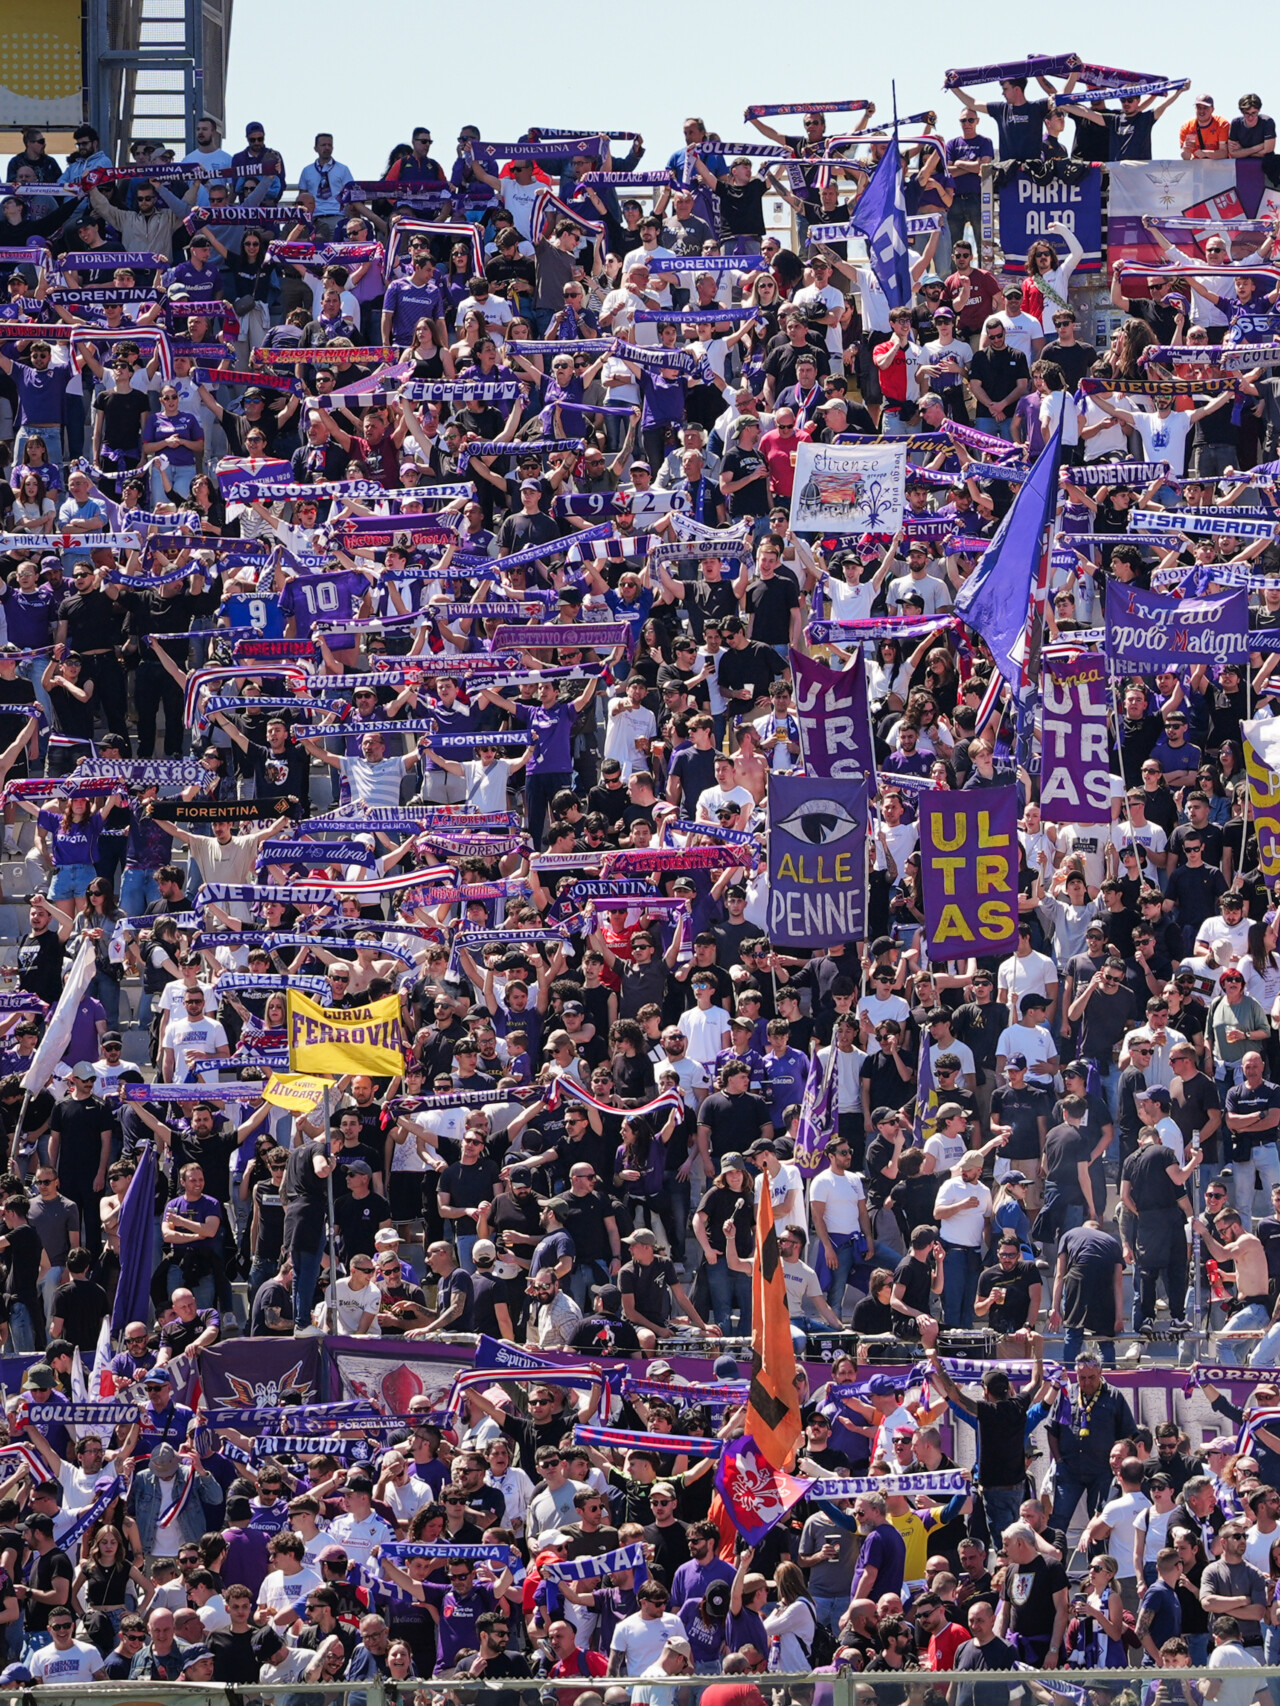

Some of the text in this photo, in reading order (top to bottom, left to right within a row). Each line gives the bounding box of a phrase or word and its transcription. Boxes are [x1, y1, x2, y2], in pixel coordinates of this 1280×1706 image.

[504, 144, 570, 154] FIORENTINA
[106, 166, 183, 178] FIORENTINA
[603, 173, 645, 183] MOLLARE
[1018, 178, 1084, 204] PARTE
[211, 207, 301, 219] FIORENTINA
[1026, 210, 1076, 235] ALTA
[75, 254, 142, 264] FIORENTINA
[660, 259, 748, 270] FIORENTINA
[53, 289, 158, 302] FIORENTINA
[280, 348, 370, 359] FIORENTINA
[308, 354, 337, 363] ITALIA
[624, 345, 663, 364] FIRENZE
[412, 383, 517, 400] FIORENTINA
[1102, 379, 1236, 394] VIEUSSEUX
[815, 448, 878, 471] Firenze
[1074, 464, 1164, 484] FIORENTINA
[230, 482, 342, 499] 26 AGOSTO
[396, 482, 472, 498] MERDA
[1199, 506, 1268, 515] FIORENTINA
[1134, 513, 1271, 537] PISA MERDA
[14, 535, 49, 546] FORZA
[120, 561, 200, 586] FIORENTINA
[1213, 571, 1265, 586] PISA
[301, 582, 341, 613] 10
[249, 600, 267, 627] 9
[448, 602, 520, 617] FORZA VIOLA
[1126, 589, 1225, 625] Ingrato
[422, 658, 501, 670] FIORENTINA
[306, 671, 401, 689] COLLETTIVO
[796, 673, 853, 711] UL
[1044, 671, 1108, 716] UL
[208, 698, 240, 709] VIVA
[441, 731, 533, 746] FIORENTINA
[1045, 720, 1108, 764] TR
[1040, 766, 1111, 809] AS
[176, 805, 259, 817] FIORENTINA
[453, 812, 510, 825] FIORENTINA
[930, 810, 1010, 851] UL
[326, 841, 369, 861] ultras
[777, 853, 853, 884] ALLE
[931, 854, 1011, 895] TR
[254, 887, 339, 906] MERDA
[771, 890, 864, 935] PENNE
[932, 902, 1016, 944] AS
[322, 1007, 373, 1020] CURVA
[292, 1011, 402, 1051] FERROVIA
[195, 1061, 220, 1073] ACF
[424, 1087, 510, 1107] FIORENTINA
[29, 1405, 138, 1424] COLLETTIVO
[215, 1402, 372, 1421] FIRENZE
[336, 1419, 407, 1429] PORCELLINO
[287, 1437, 347, 1455] LUCIDI
[815, 1475, 967, 1498] SETTE BELLO
[396, 1545, 501, 1558] FIORENTINA
